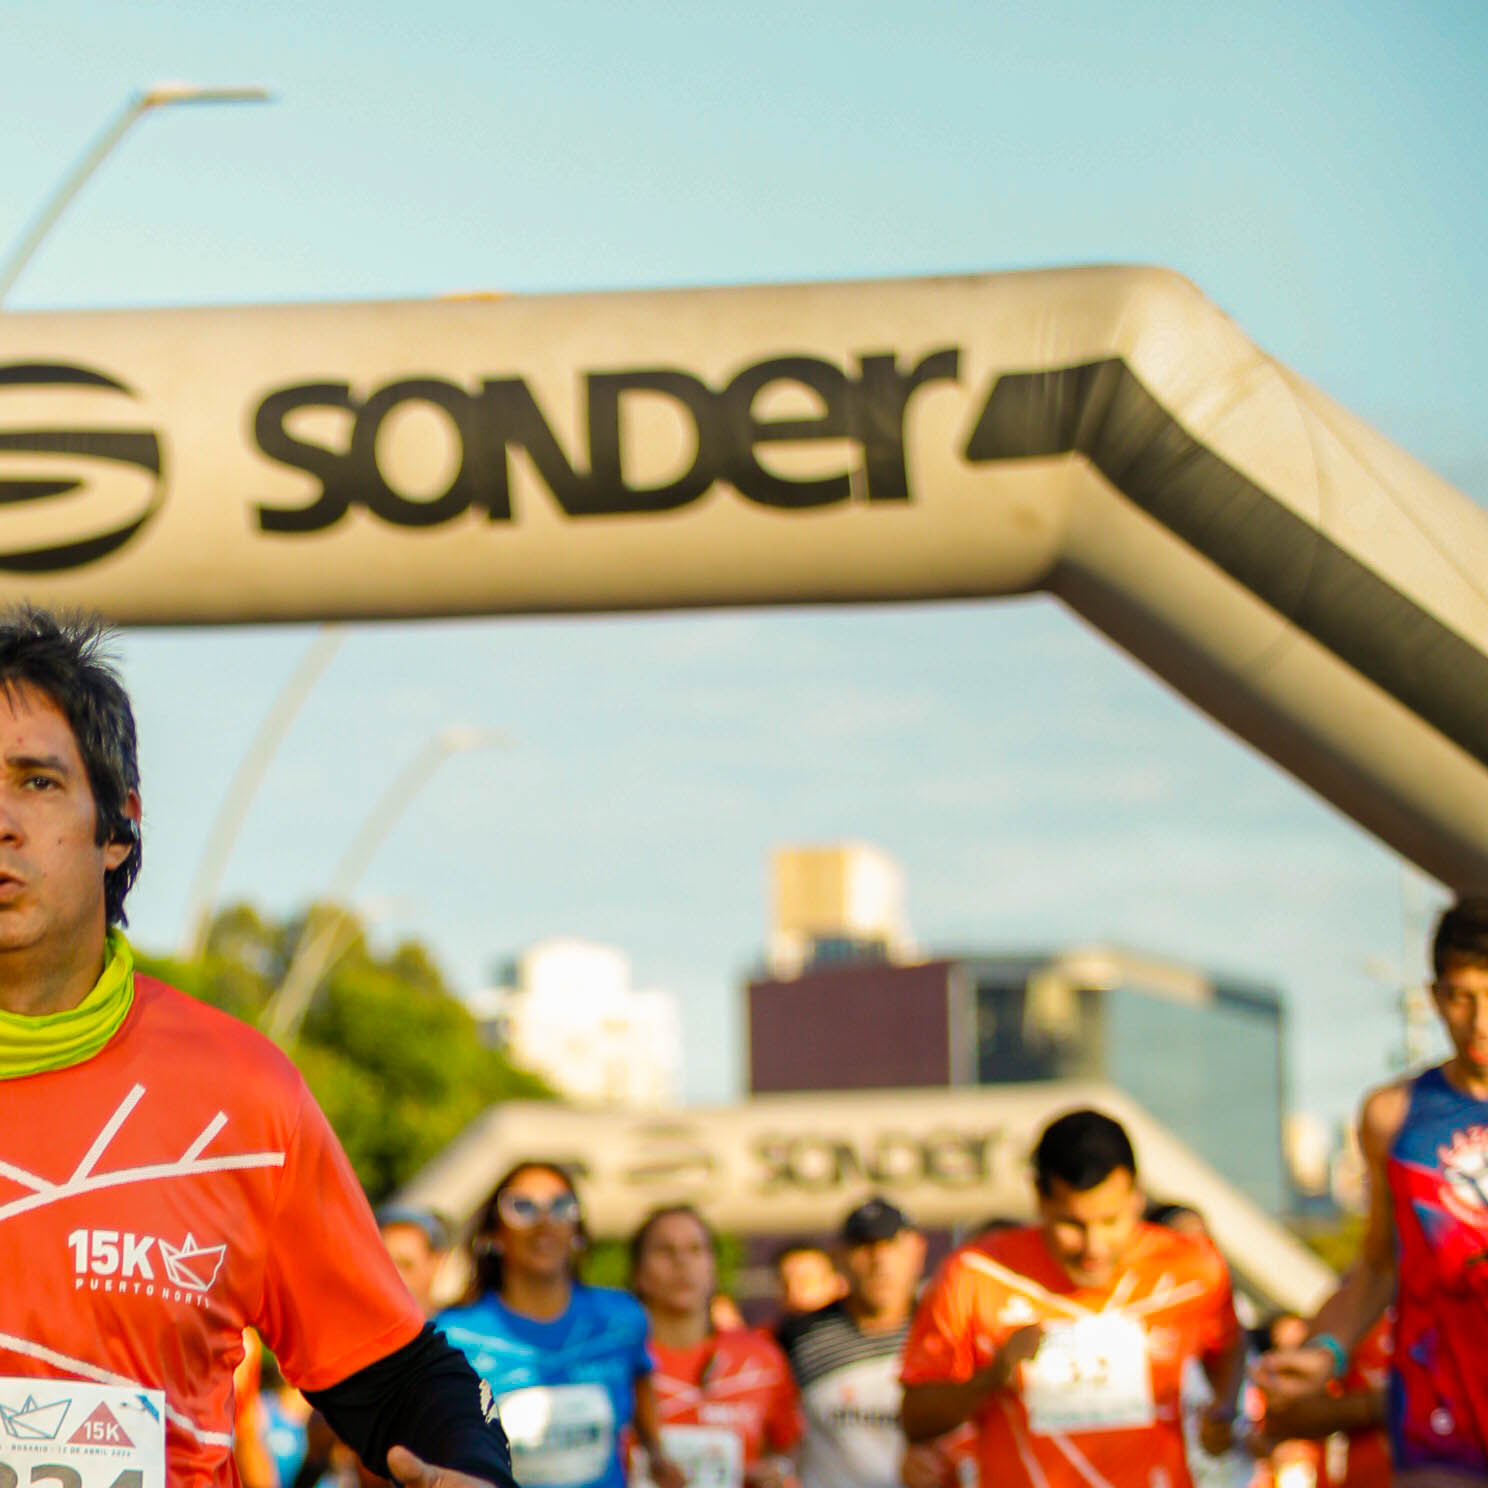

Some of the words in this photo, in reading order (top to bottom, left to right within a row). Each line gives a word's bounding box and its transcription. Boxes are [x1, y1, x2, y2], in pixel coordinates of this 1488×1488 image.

[68, 1229, 157, 1280] 15K
[75, 1278, 155, 1296] PUERTO
[83, 1420, 120, 1442] 15K
